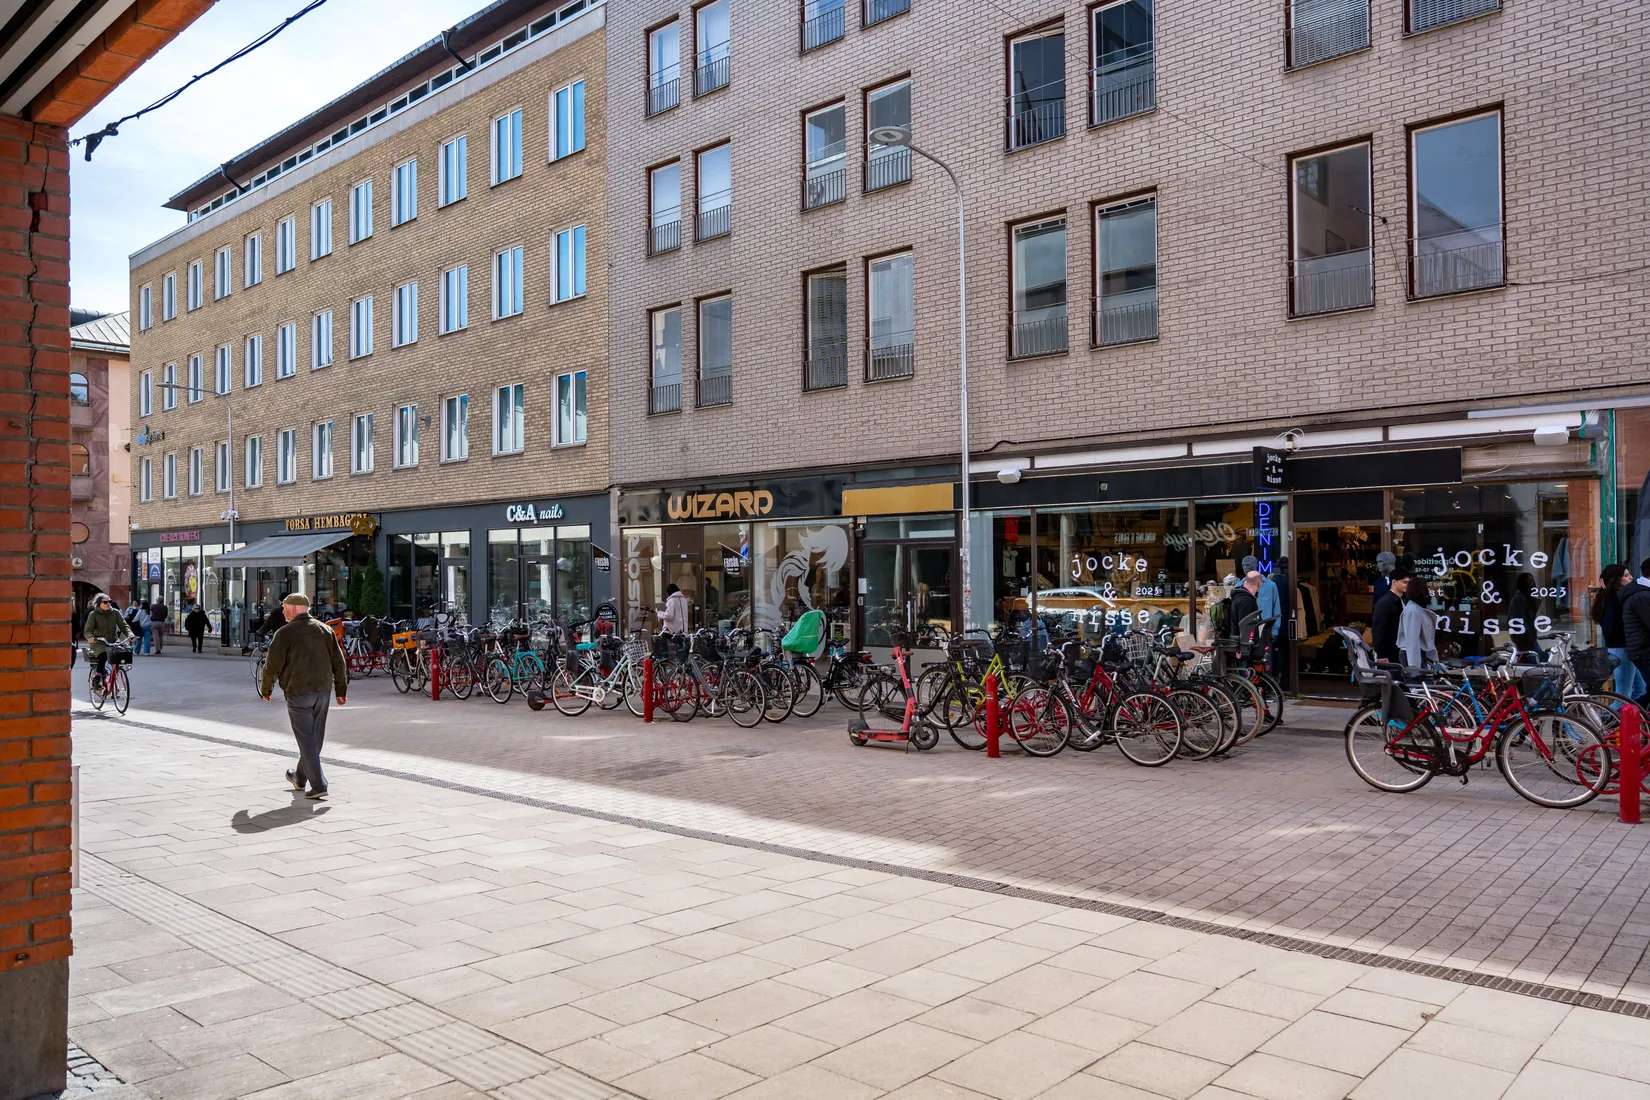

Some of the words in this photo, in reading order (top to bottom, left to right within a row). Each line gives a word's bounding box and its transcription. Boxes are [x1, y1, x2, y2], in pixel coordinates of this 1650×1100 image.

[506, 503, 537, 522] C&A
[540, 503, 563, 520] nails
[667, 489, 774, 519] WIZARD
[285, 517, 311, 531] FORSA
[1258, 502, 1272, 574] DENIM
[1071, 552, 1148, 579] jocke
[1433, 543, 1549, 576] jocke
[1102, 581, 1118, 600] &
[1480, 580, 1502, 604] &
[1530, 587, 1567, 597] 2023
[1070, 605, 1150, 625] nisse
[1435, 611, 1552, 635] nisse
